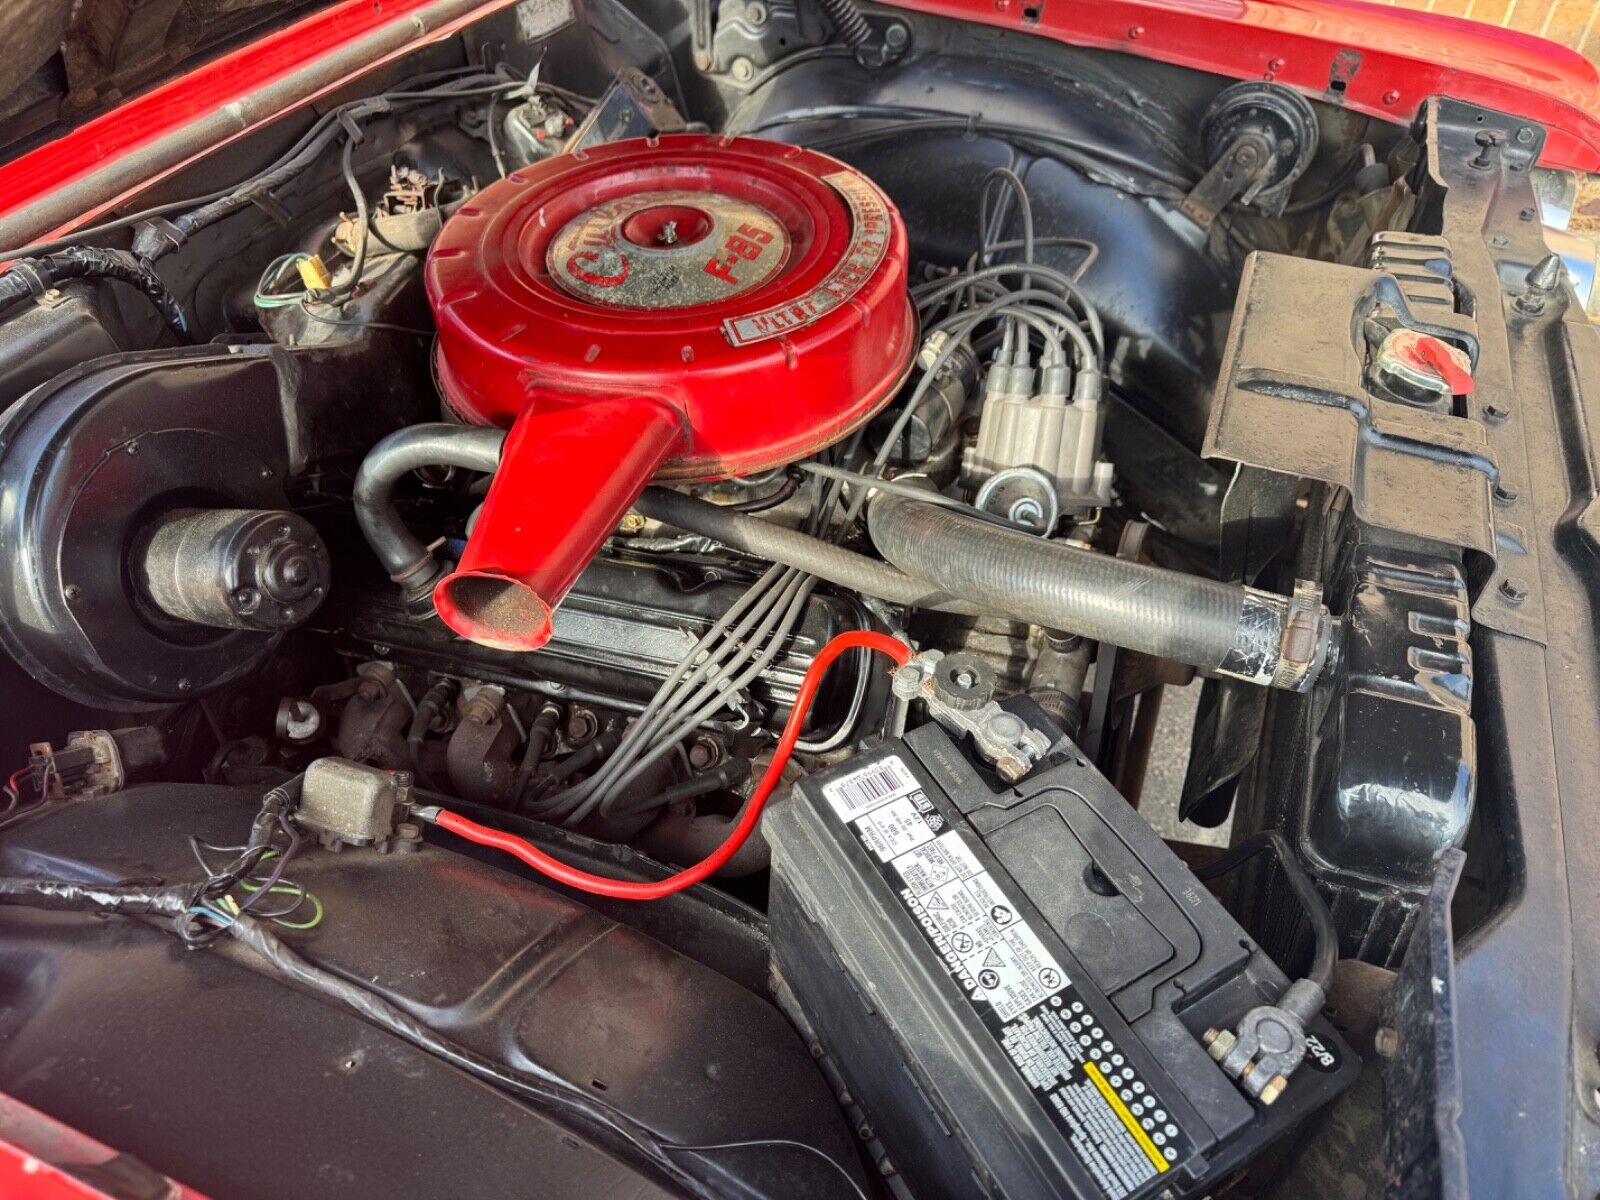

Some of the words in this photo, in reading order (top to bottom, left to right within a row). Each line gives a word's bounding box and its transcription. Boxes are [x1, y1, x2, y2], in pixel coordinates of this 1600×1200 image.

[903, 817, 913, 827] 45
[910, 811, 922, 824] 12V
[863, 824, 886, 852] 96RPRM
[899, 886, 977, 990] DANGER/POISON
[994, 1000, 1010, 1019] SHIELD
[1305, 1034, 1335, 1067] 8/22
